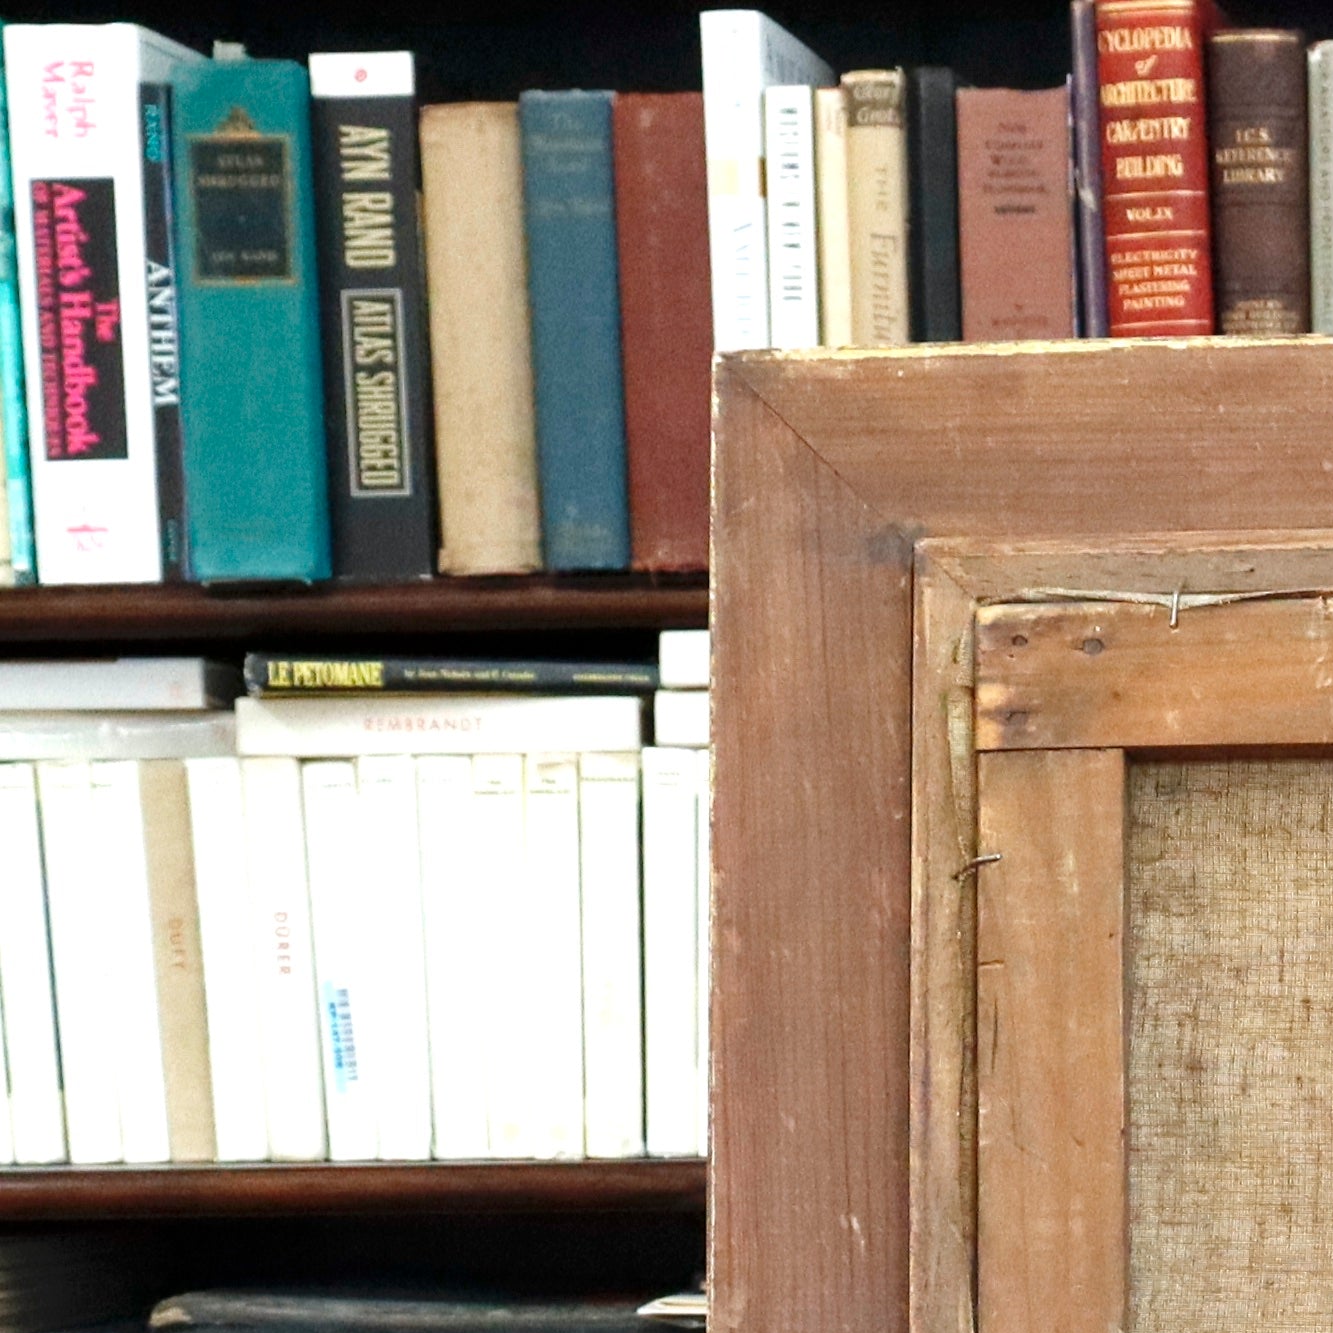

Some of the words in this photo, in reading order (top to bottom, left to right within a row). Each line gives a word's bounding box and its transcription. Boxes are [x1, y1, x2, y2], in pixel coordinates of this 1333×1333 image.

[68, 60, 96, 138] Ralph
[339, 125, 390, 180] AYN
[1106, 116, 1191, 144] CARPENTRY
[1116, 153, 1184, 180] BUILDING
[52, 182, 91, 284] Artist's
[343, 192, 394, 269] RAND
[1111, 249, 1198, 265] ELECTRICITY
[1154, 262, 1197, 277] METAL
[1119, 279, 1191, 296] PLASTERING
[1124, 296, 1185, 311] PAINTING
[94, 301, 120, 340] The
[147, 261, 180, 407] ANTHEM
[353, 301, 392, 364] ATLAS
[61, 291, 100, 454] Handbook
[356, 371, 398, 487] SHRUGGED
[266, 661, 290, 687] LE
[292, 661, 385, 688] PETOMANE
[363, 716, 483, 732] REMBRANDT
[168, 917, 186, 970] DUFY
